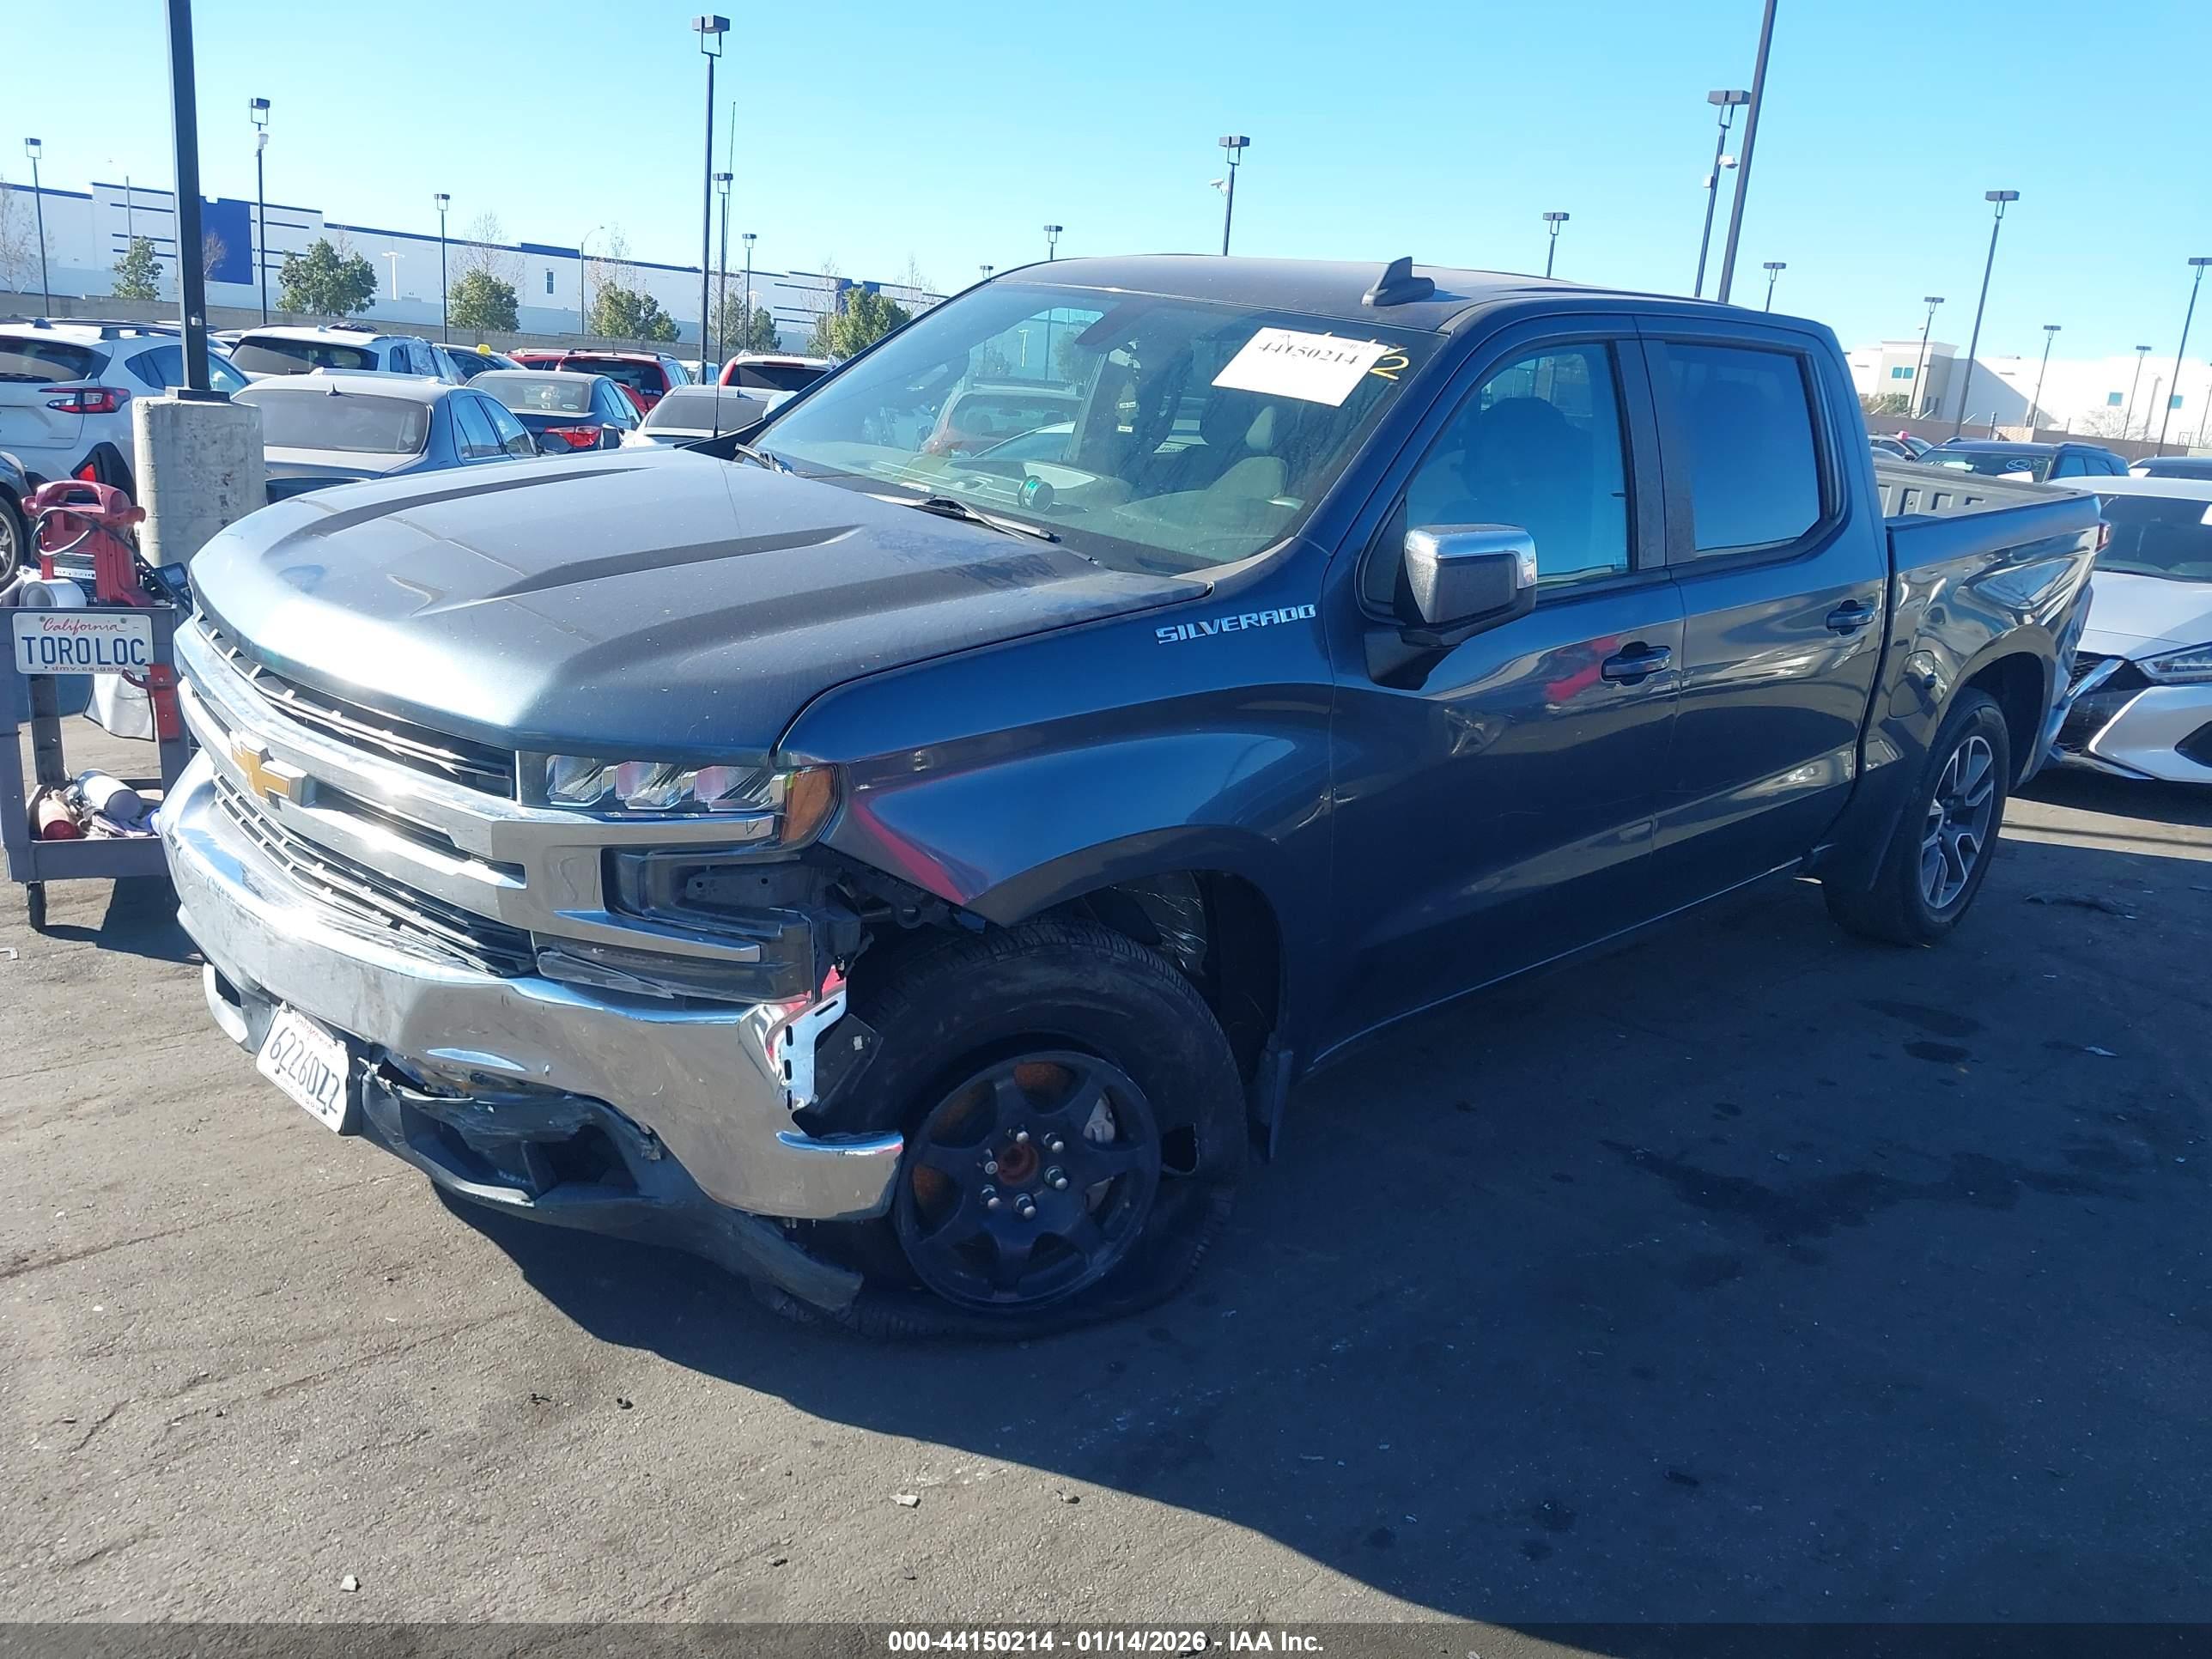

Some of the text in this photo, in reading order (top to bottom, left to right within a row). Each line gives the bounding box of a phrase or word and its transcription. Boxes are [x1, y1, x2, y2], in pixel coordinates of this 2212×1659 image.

[1258, 341, 1361, 366] 44150214
[43, 617, 126, 636] California
[1155, 604, 1316, 645] SILVERADO
[21, 636, 146, 665] TOROLOC
